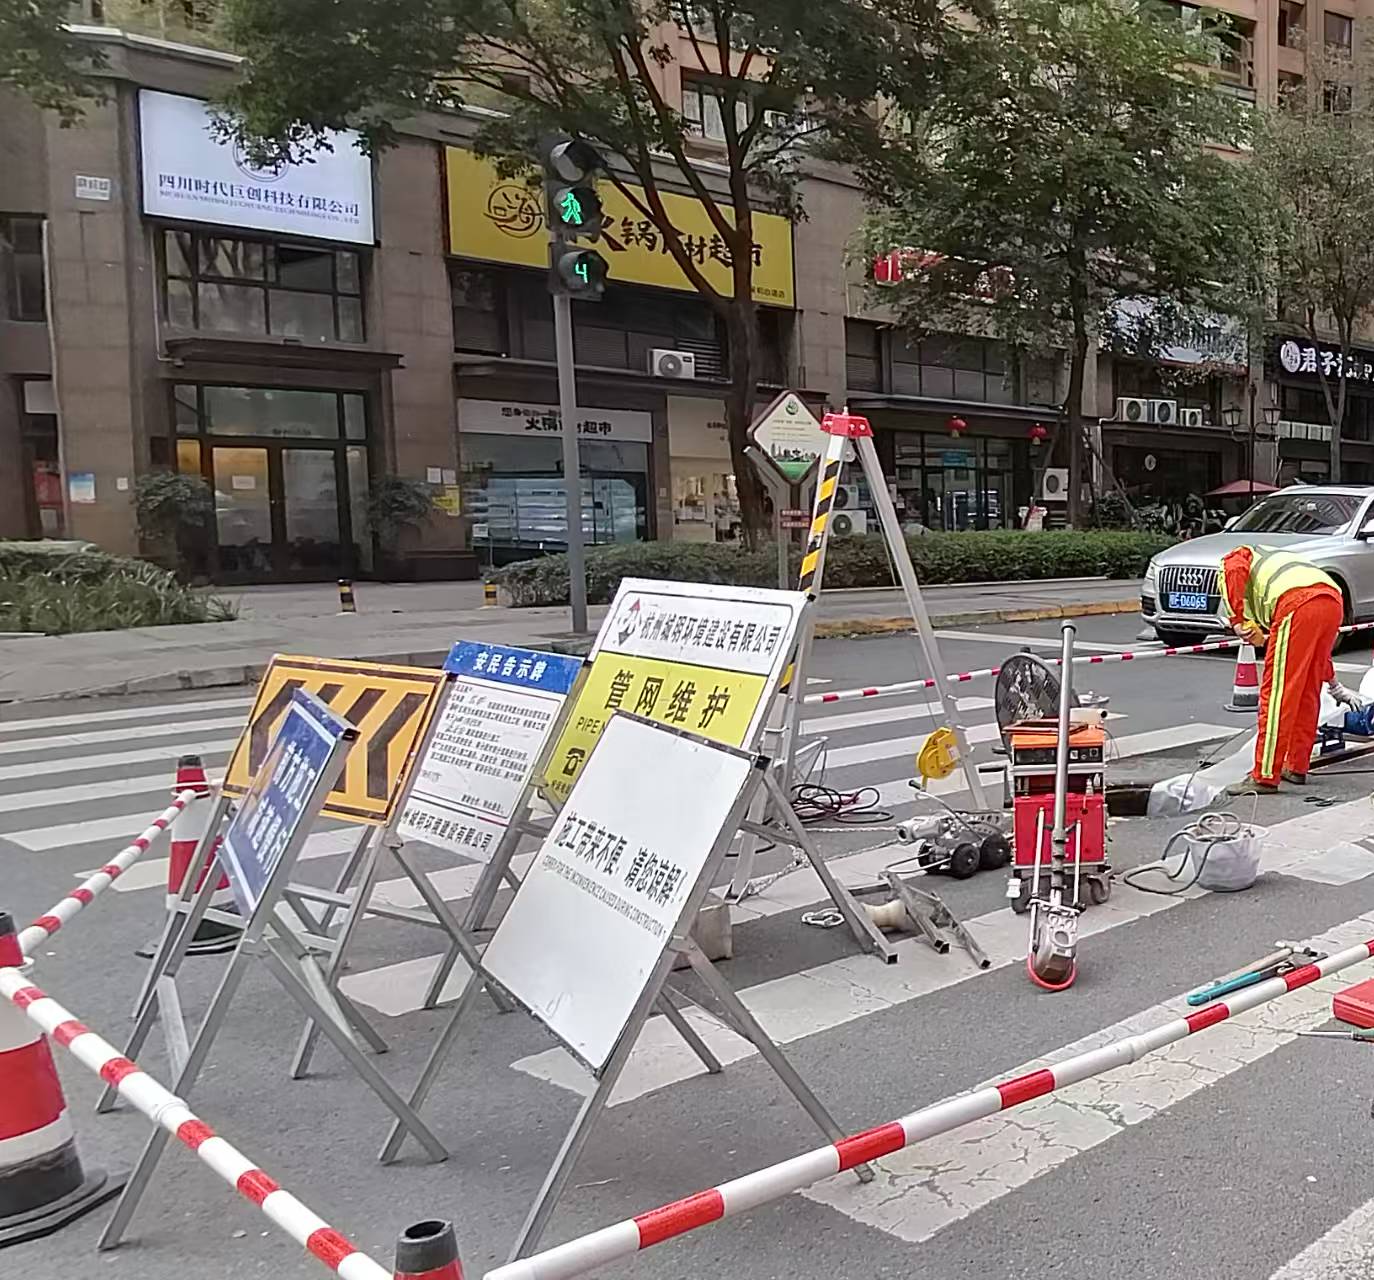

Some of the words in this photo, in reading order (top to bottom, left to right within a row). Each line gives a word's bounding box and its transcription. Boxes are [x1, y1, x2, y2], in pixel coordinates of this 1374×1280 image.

[158, 173, 358, 217] 四川时代巨创科技有限公司
[590, 213, 763, 268] 火锅材超
[575, 262, 588, 284] 4
[473, 652, 547, 681] 安民告示牌
[604, 669, 731, 729] 管网维护
[576, 716, 600, 734] PIPE
